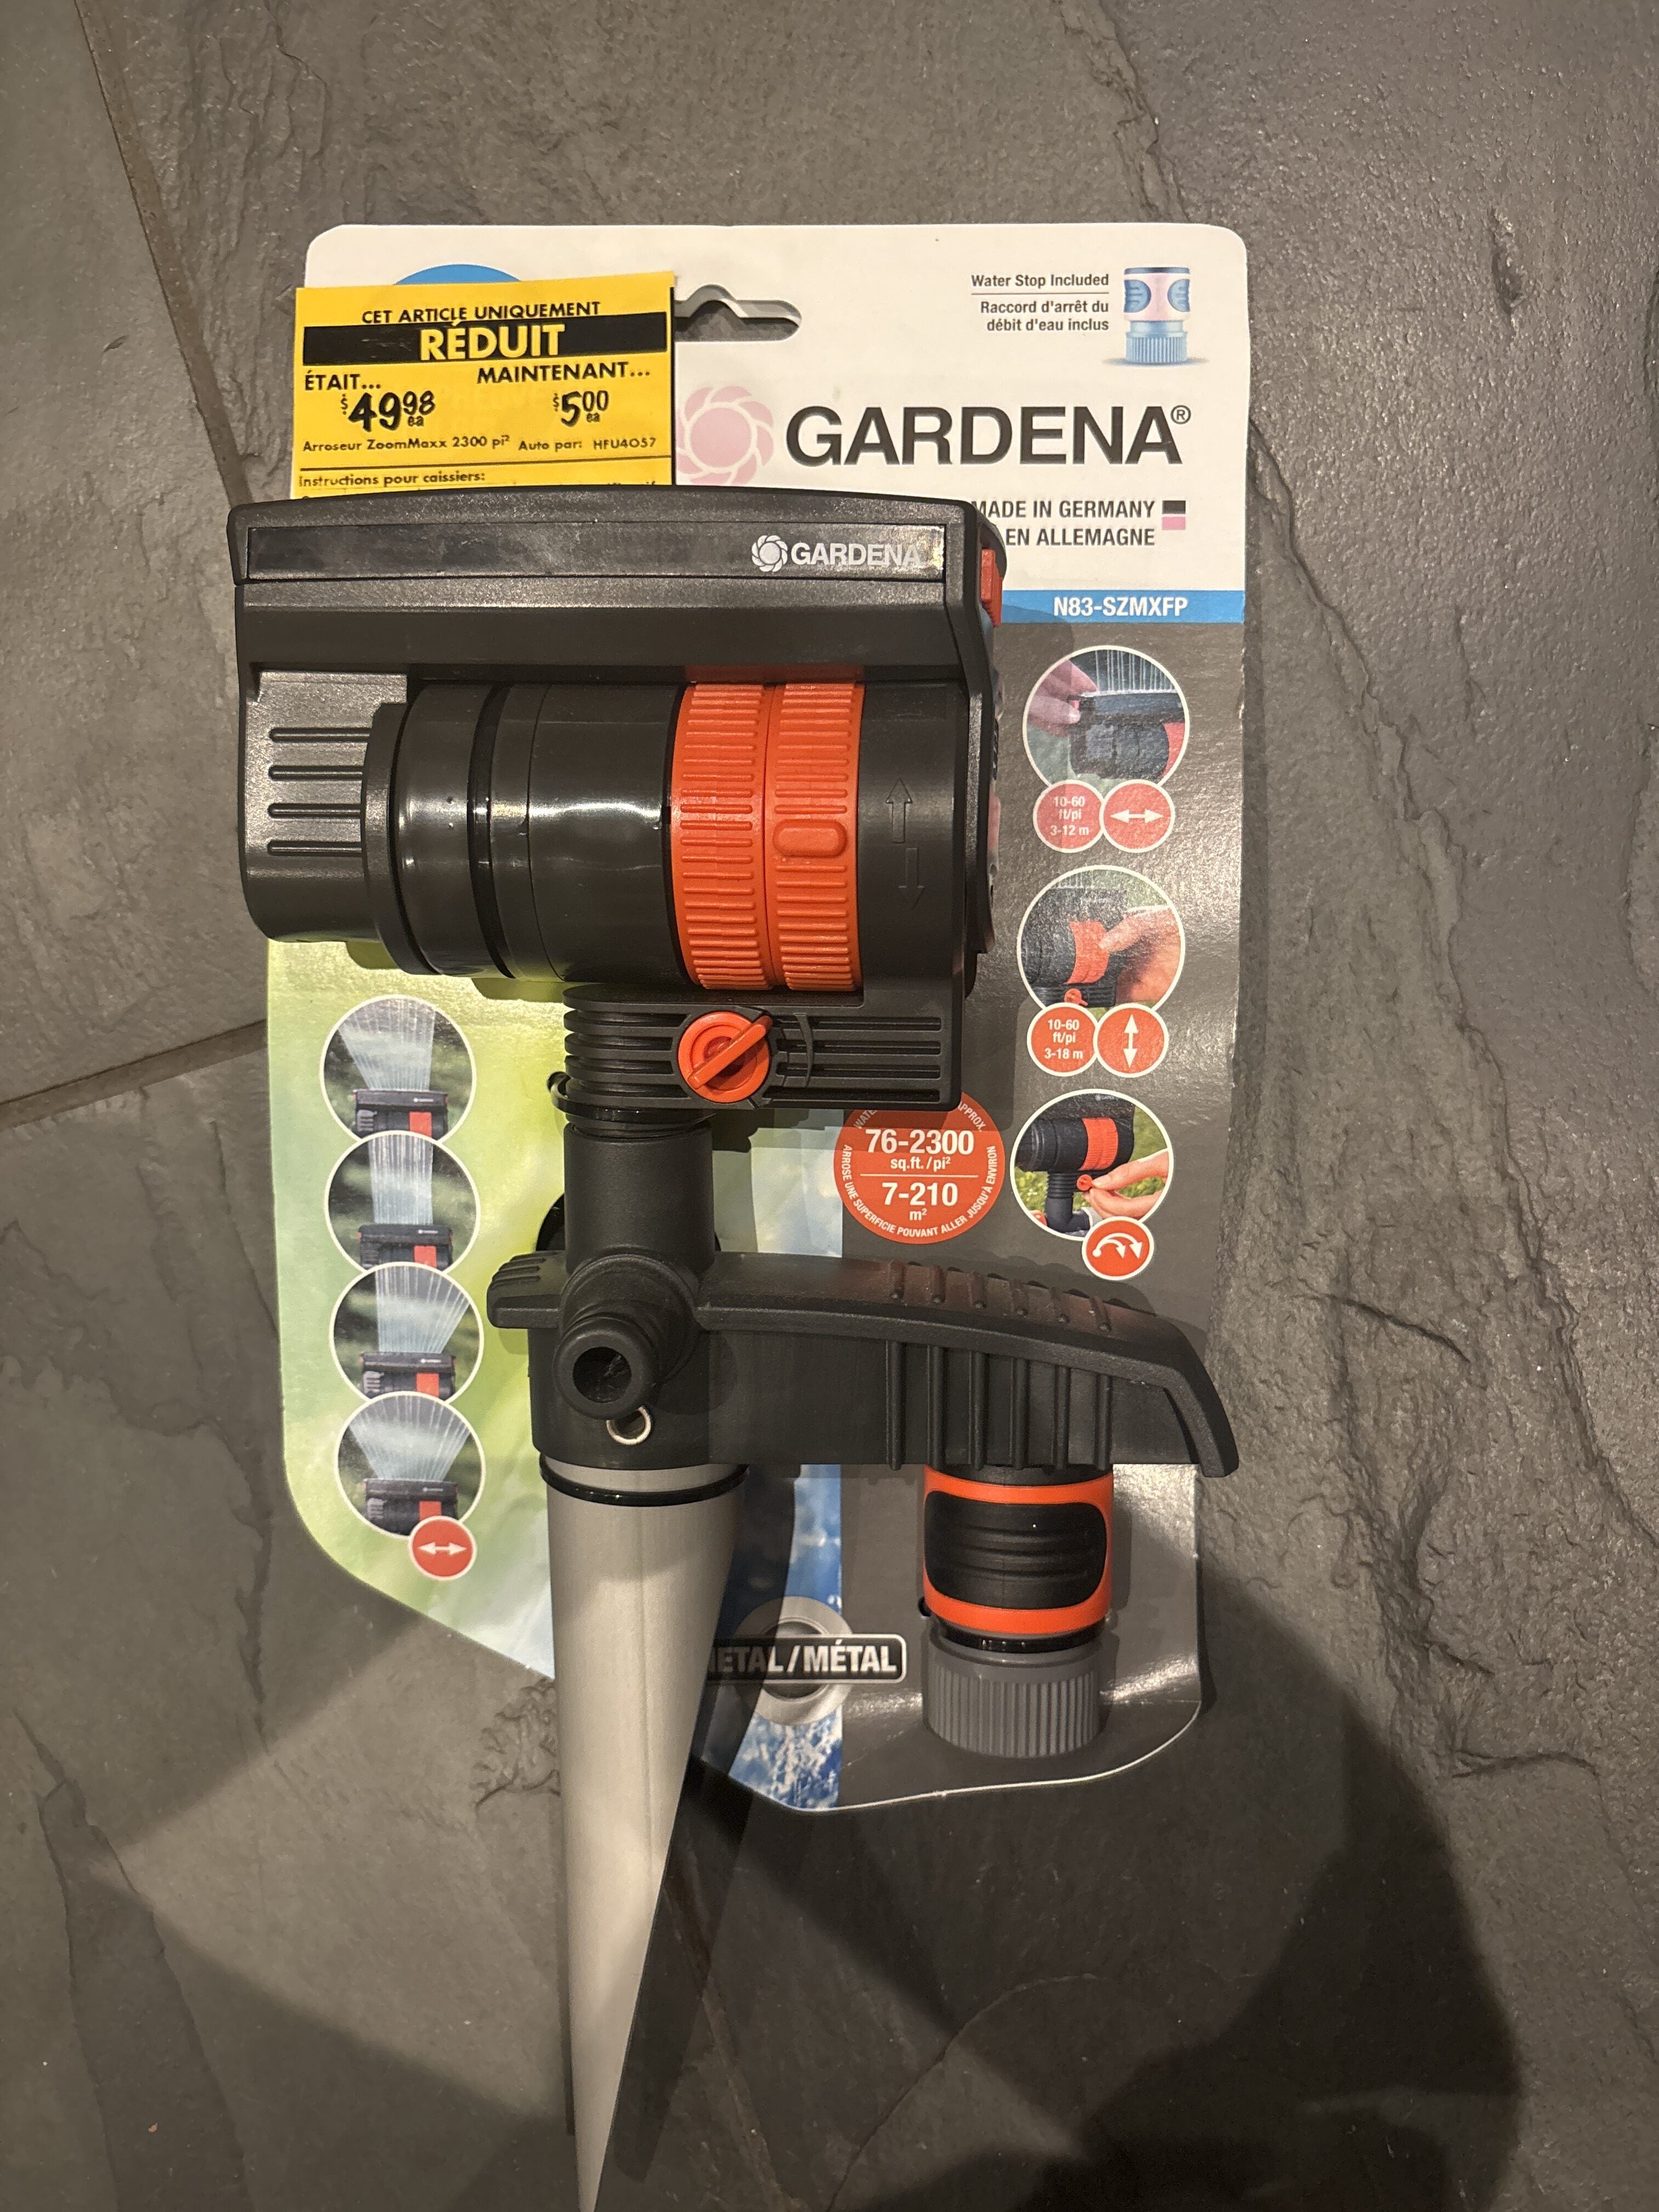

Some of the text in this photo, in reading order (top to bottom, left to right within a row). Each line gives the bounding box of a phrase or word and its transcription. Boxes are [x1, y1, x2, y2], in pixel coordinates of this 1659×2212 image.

[971, 274, 1109, 289] Water Stop Included
[362, 301, 600, 324] CET ARTICLE UNIQUEMENT
[980, 300, 1109, 313] Raccord d'arrêt du
[987, 318, 1109, 331] débit d'eau inclus
[420, 319, 566, 361] RÉDUIT
[304, 369, 381, 391] ÉTAIT...
[477, 362, 651, 384] MAINTENANT...
[407, 415, 424, 427] ea
[586, 413, 601, 422] ea
[303, 441, 362, 452] Arroseur
[367, 437, 447, 450] ZoomMaxx
[452, 436, 487, 448] 2300
[518, 441, 549, 451] Auto
[299, 470, 485, 488] Instructions pour caissiers:
[1034, 500, 1051, 518] IN
[1059, 500, 1155, 518] GERMANY
[1006, 528, 1155, 546] EN ALLEMAGNE
[791, 542, 921, 566] GARDENA
[1054, 597, 1188, 617] N83-SZMXFP
[1054, 796, 1085, 807] 10-60
[1058, 808, 1082, 822] ft/pi
[1050, 825, 1089, 836] 3-12 m
[1047, 1019, 1080, 1030] 10-60
[1052, 1031, 1076, 1045] ft/pi
[1044, 1047, 1083, 1059] 3-18 m
[865, 1128, 974, 1155] 76-2300
[841, 1144, 997, 1237] ARROSE UNE SUPERFICIE POUVANT ALLER JUSQU'À ENVIRON
[882, 1182, 958, 1206] 7-210
